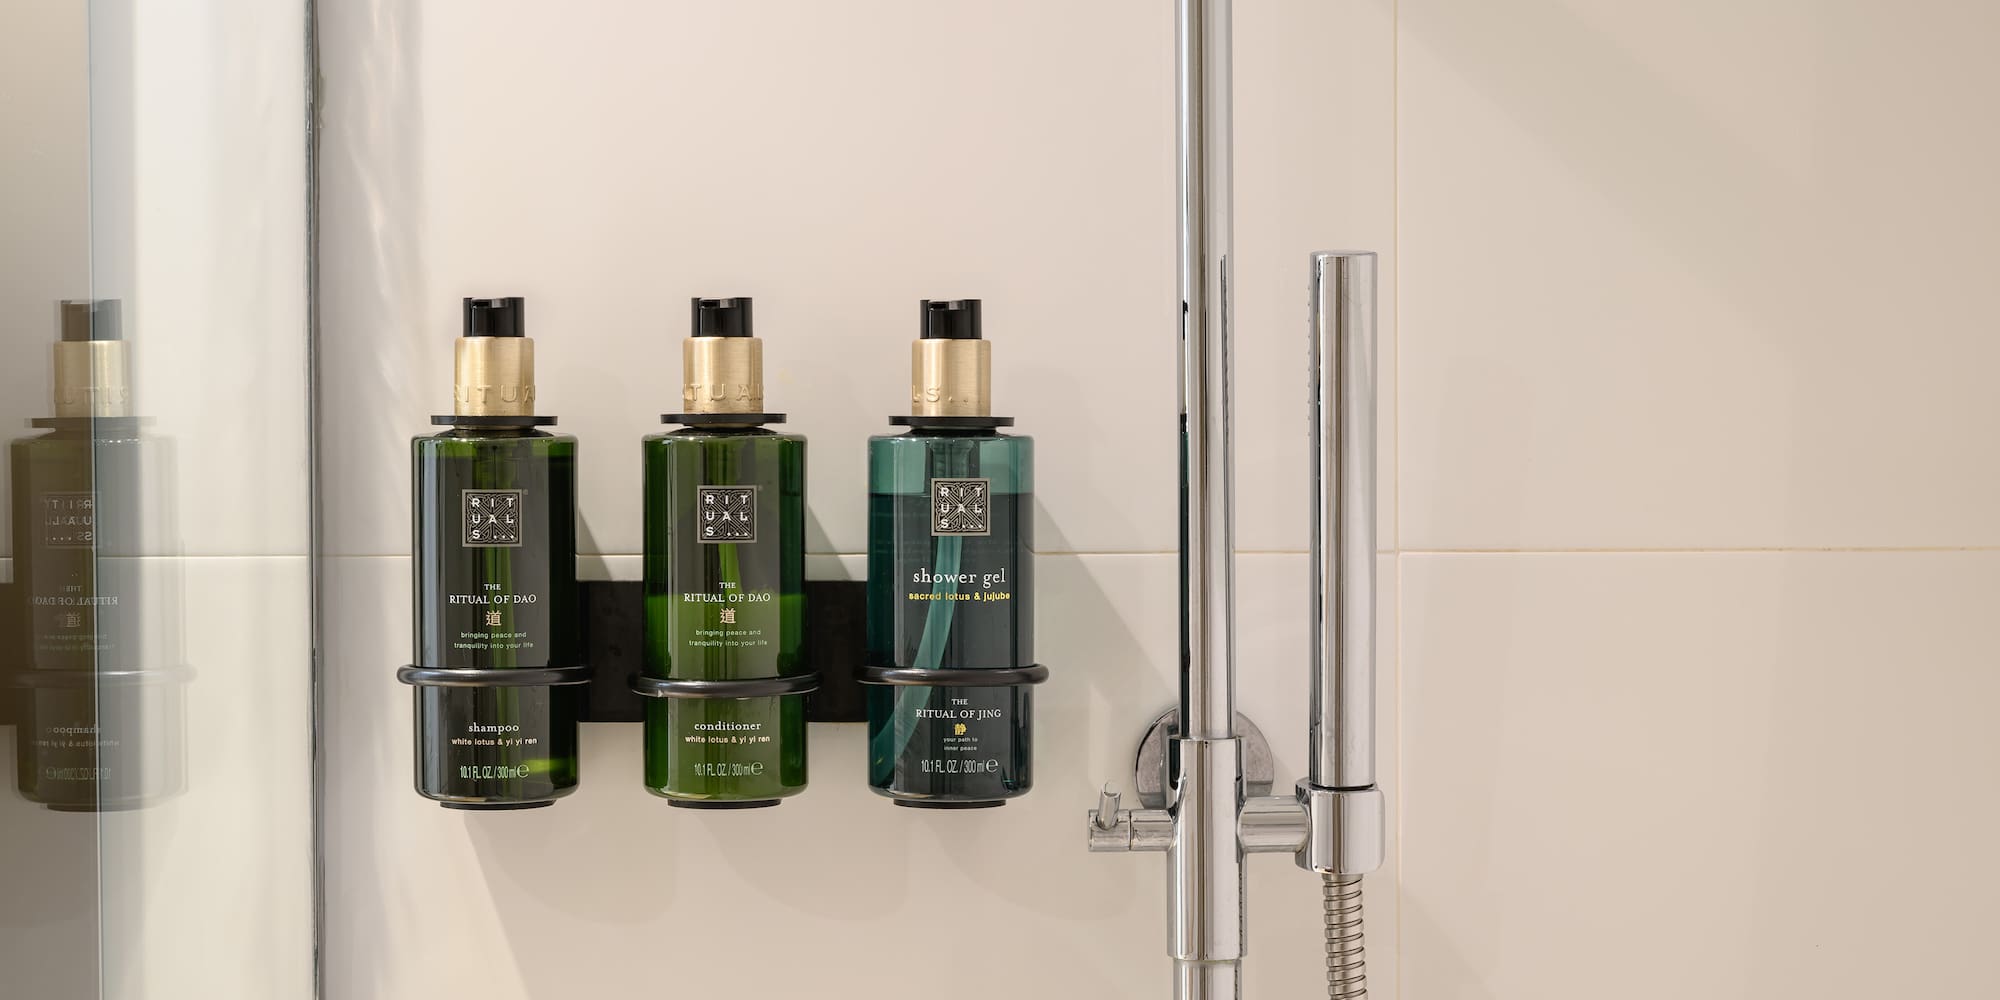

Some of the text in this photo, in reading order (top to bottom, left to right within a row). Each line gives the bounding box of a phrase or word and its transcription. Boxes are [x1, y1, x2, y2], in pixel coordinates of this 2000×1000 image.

[913, 567, 1006, 589] shower gel
[449, 594, 537, 604] RITUAL OF DAO
[684, 593, 771, 603] RITUAL OF DAO
[909, 591, 1011, 602] sacred lotus & jujube
[485, 610, 502, 626] 道
[720, 608, 736, 624] 道
[460, 632, 489, 640] bringing
[695, 629, 724, 637] bringing
[454, 642, 488, 650] tranquility
[689, 640, 723, 648] tranquility
[916, 709, 1001, 721] RITUAL OF JING
[468, 722, 520, 735] shampoo
[694, 721, 761, 731] conditioner
[451, 737, 538, 747] white lotus & yi yi ren
[685, 736, 705, 744] white
[739, 736, 747, 744] yi
[749, 736, 756, 744] yi
[732, 763, 743, 776] 300
[921, 760, 934, 773] 10.1
[963, 759, 977, 773] 300
[497, 765, 509, 779] 300
